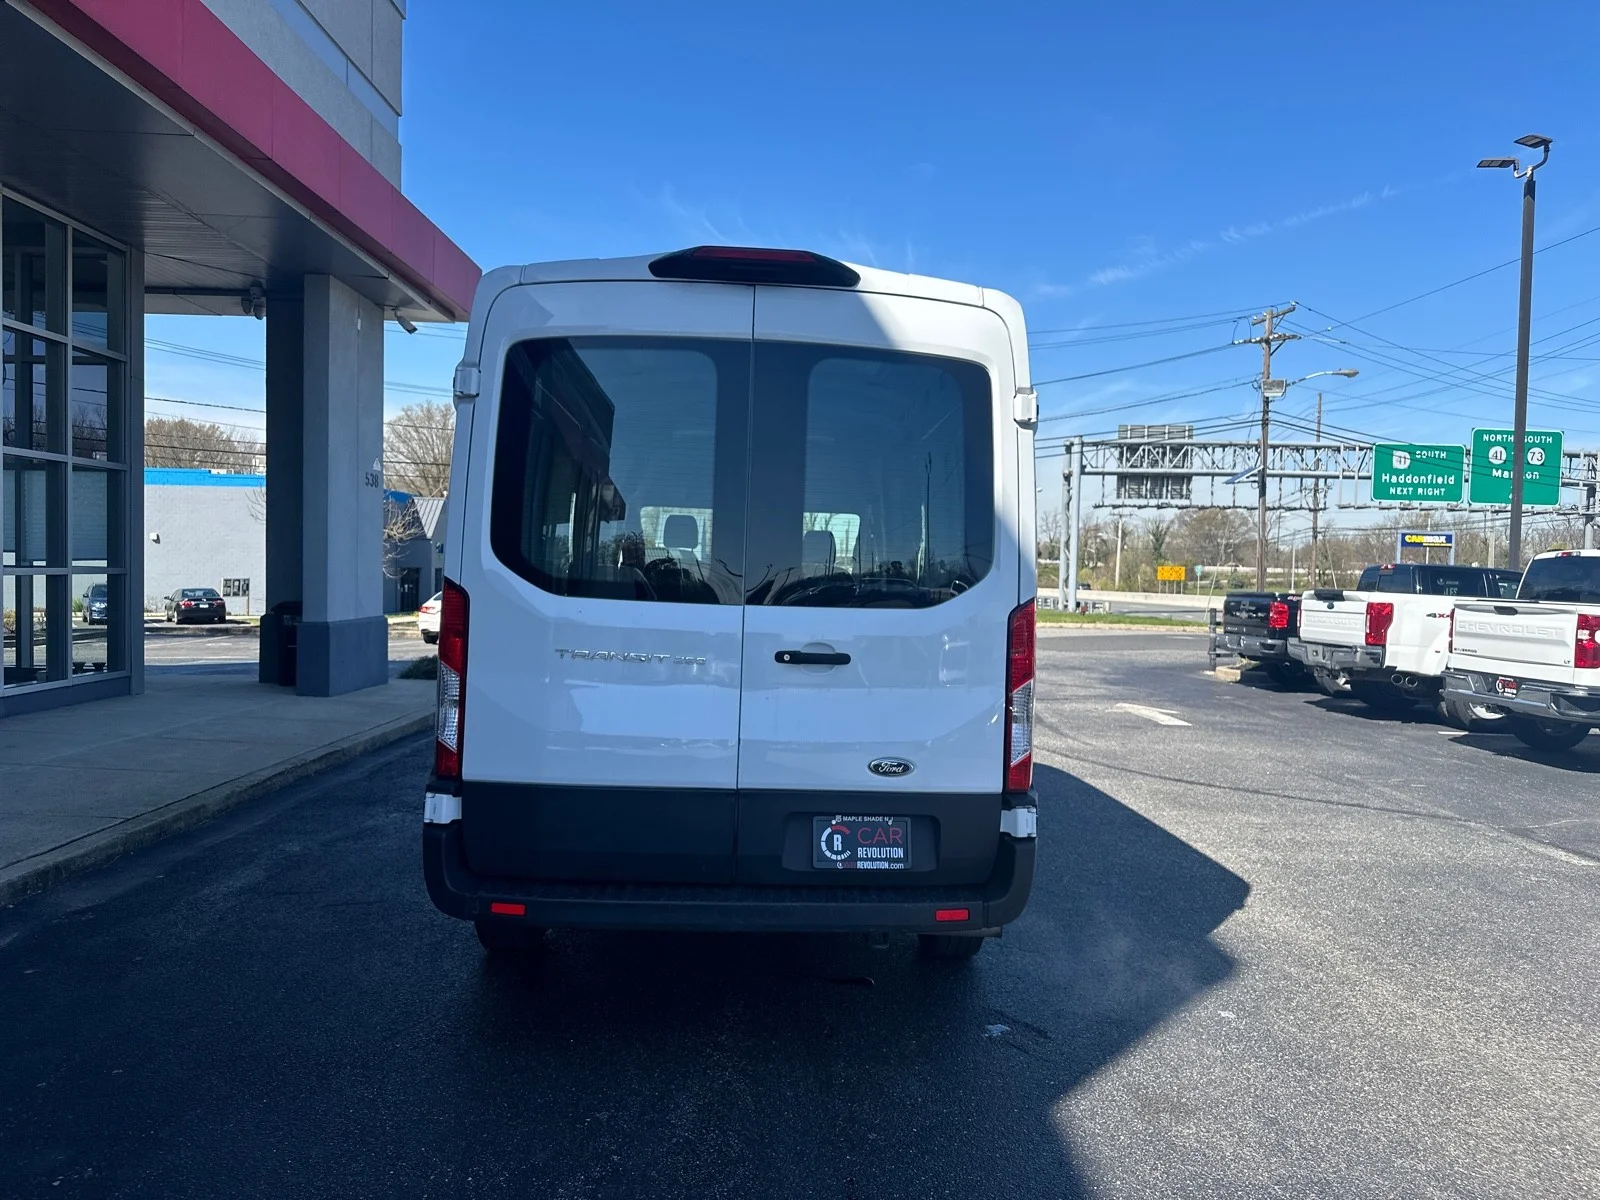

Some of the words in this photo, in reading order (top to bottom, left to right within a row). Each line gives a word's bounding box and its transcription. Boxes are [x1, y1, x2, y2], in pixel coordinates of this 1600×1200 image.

[1483, 434, 1514, 442] NORTH
[1415, 450, 1447, 459] SOUTH
[1492, 450, 1503, 460] 41
[1529, 451, 1543, 461] 73
[365, 472, 379, 488] 538
[1381, 472, 1455, 485] Haddonfield
[1492, 468, 1540, 480] Maon
[1389, 486, 1414, 495] NEXT
[1417, 487, 1446, 496] RIGHT
[1457, 620, 1563, 637] CHEVROLET
[555, 648, 671, 664] TRANSIT
[878, 761, 905, 773] Ford
[857, 827, 903, 845] CAR
[833, 834, 843, 851] R
[857, 847, 904, 859] REVOLUTION
